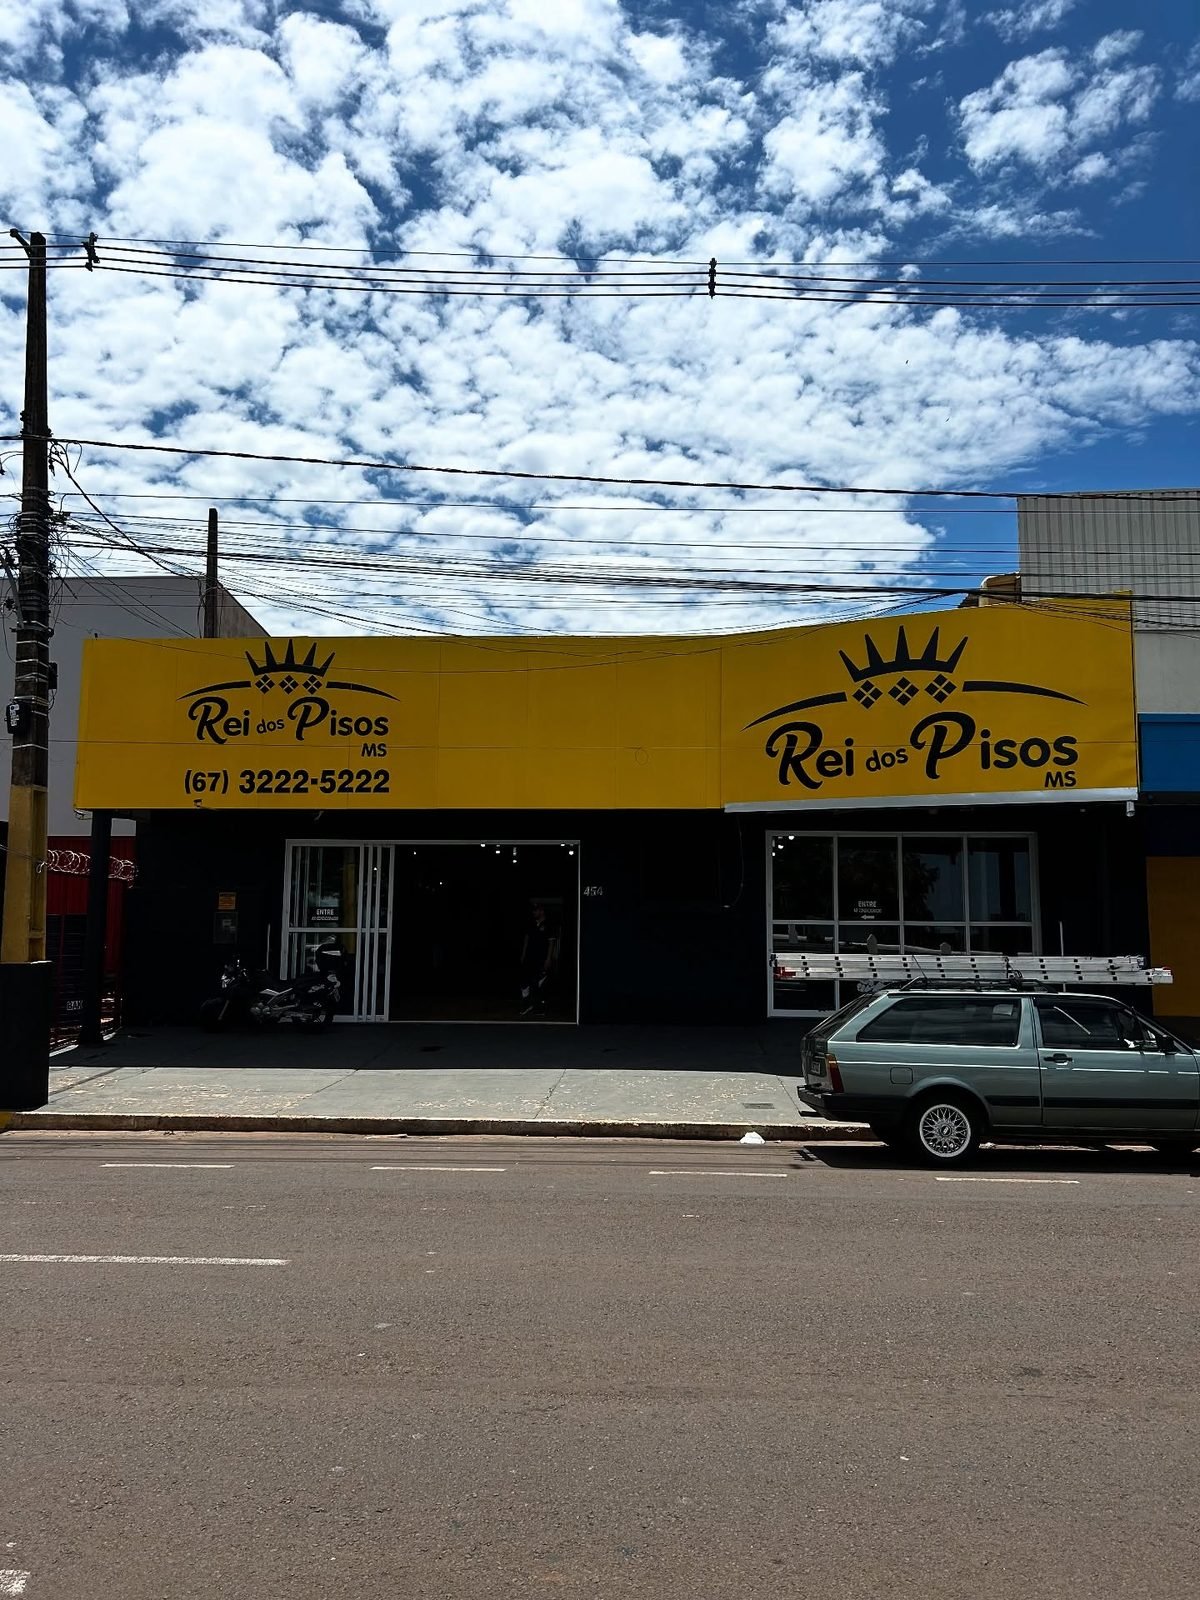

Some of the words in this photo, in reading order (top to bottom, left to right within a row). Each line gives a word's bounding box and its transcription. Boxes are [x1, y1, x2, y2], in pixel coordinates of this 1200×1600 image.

[188, 697, 250, 744] Rei
[256, 717, 284, 734] dos
[287, 697, 389, 741] Pisos
[361, 743, 387, 757] MS
[765, 721, 855, 789] Rei
[865, 747, 908, 772] dos
[910, 711, 1078, 779] Pisos
[184, 770, 229, 794] (67)
[239, 769, 390, 794] 3222-5222
[1044, 770, 1076, 788] MS
[316, 908, 335, 916] ENTRE
